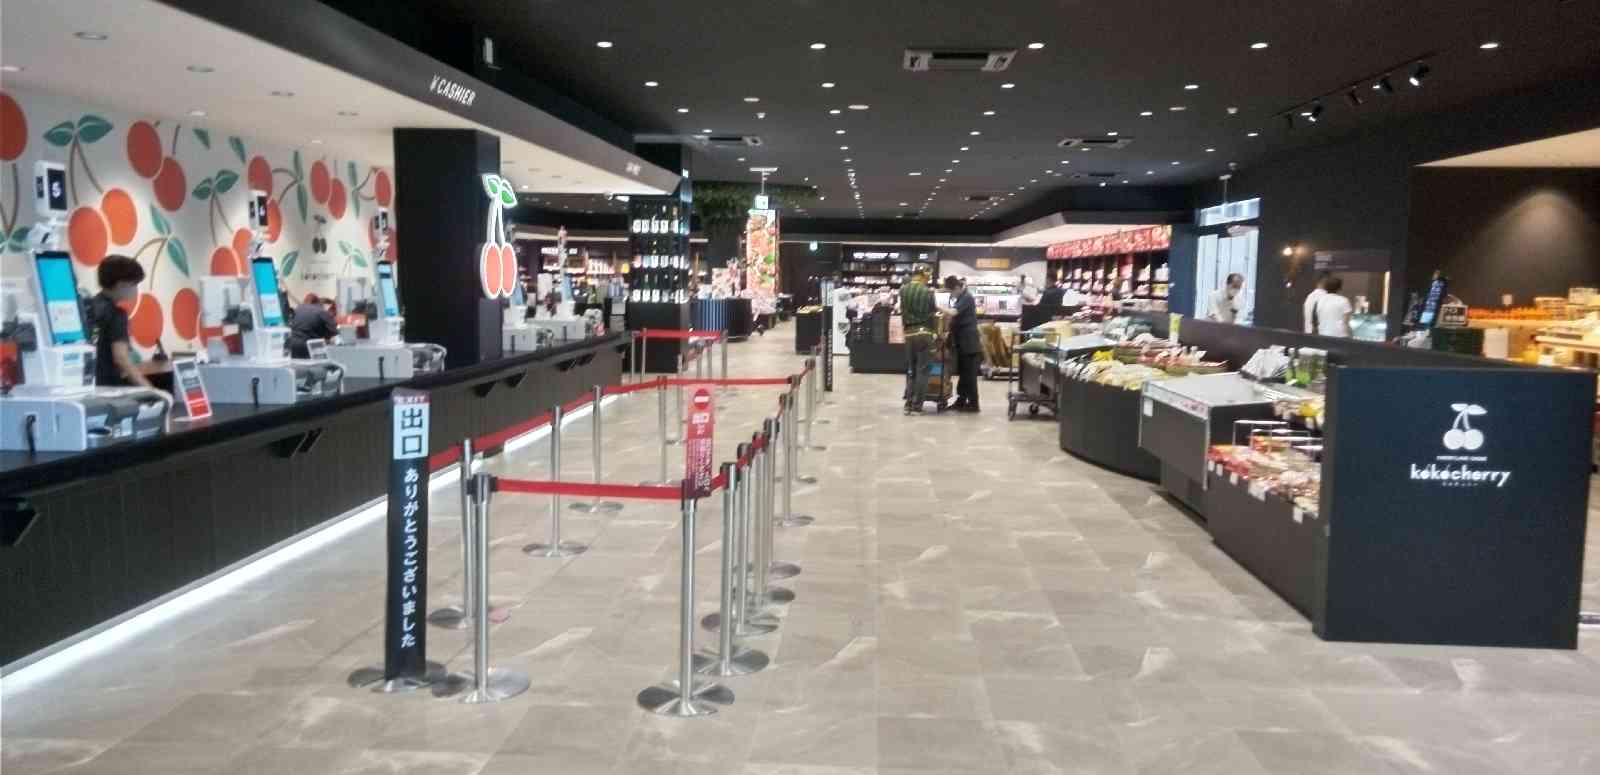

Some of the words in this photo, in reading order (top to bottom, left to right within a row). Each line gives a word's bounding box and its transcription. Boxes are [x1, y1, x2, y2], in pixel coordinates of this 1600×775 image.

[437, 79, 476, 106] CASHIER
[401, 407, 422, 455] 出口
[402, 467, 418, 648] ありがとうございました
